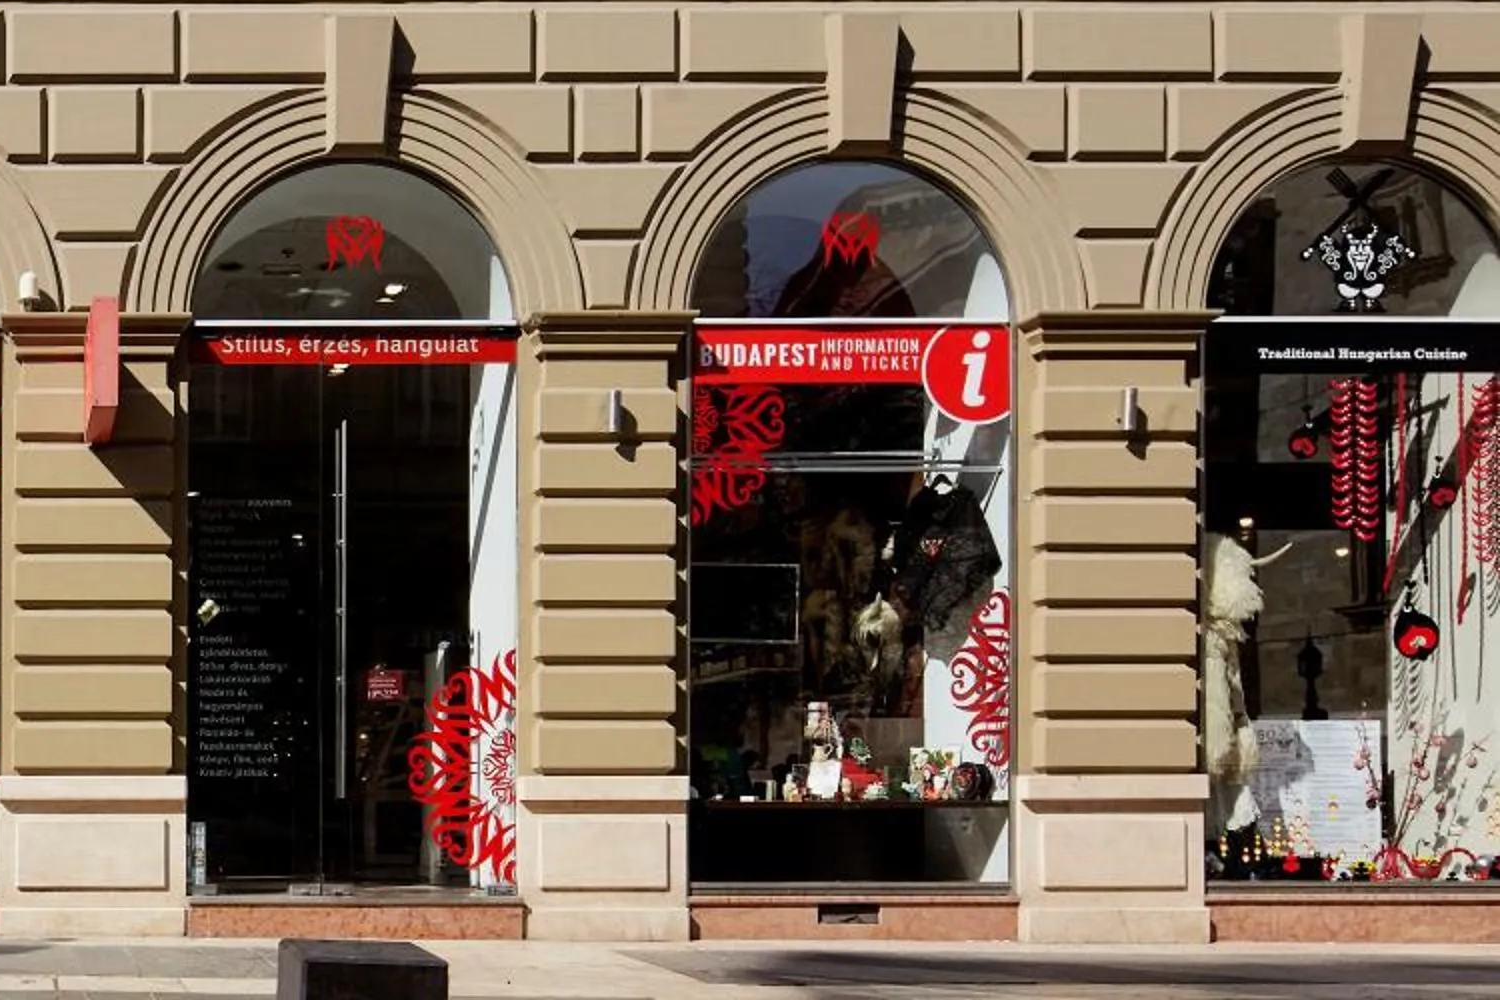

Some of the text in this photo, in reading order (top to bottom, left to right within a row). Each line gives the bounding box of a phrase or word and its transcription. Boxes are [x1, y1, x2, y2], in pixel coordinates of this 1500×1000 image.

[821, 338, 919, 354] INFORMATION
[700, 343, 819, 368] BUDAPEST
[821, 355, 919, 371] AND TICKET
[1258, 347, 1468, 363] Traditional Hungarian Cuisine
